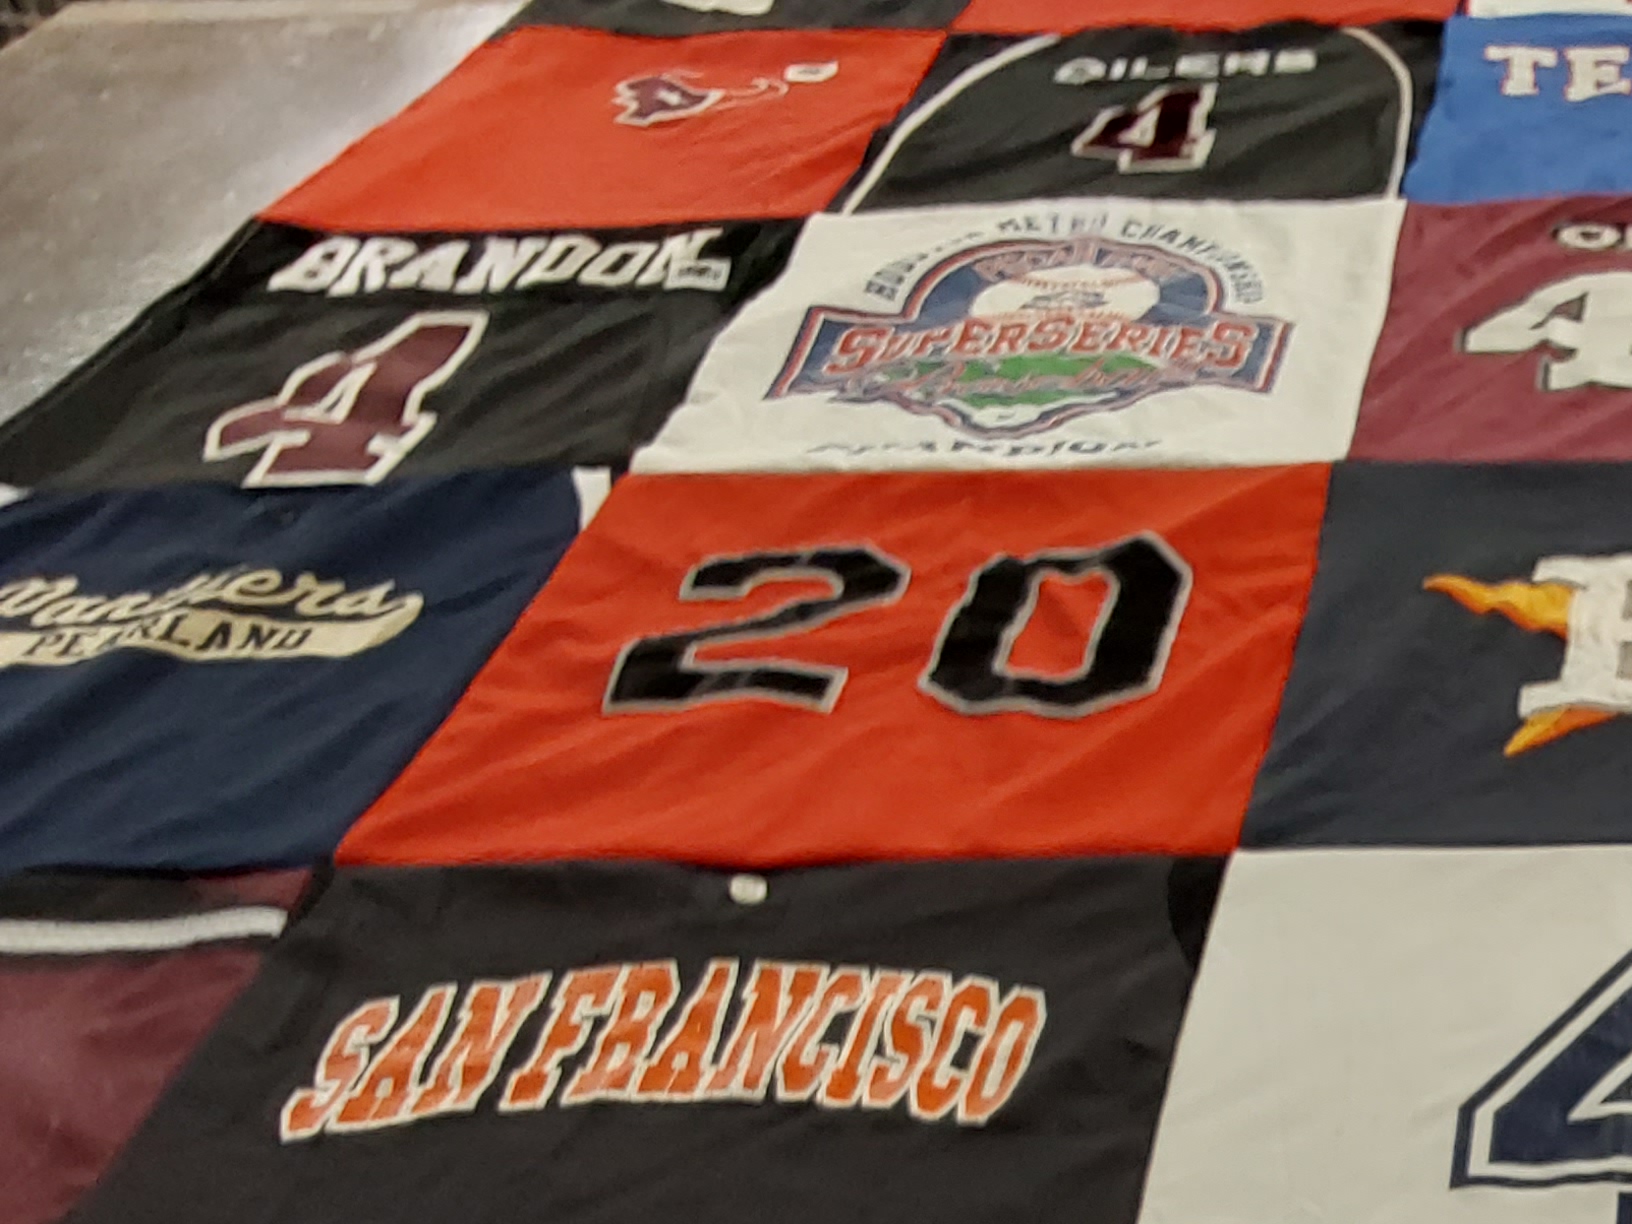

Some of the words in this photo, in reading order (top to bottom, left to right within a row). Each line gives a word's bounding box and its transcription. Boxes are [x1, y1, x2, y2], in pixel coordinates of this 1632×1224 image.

[1070, 81, 1219, 174] 4
[265, 226, 723, 296] BRANDON
[203, 310, 490, 488] 4
[602, 530, 1195, 720] 20
[280, 972, 552, 1144] SAN
[497, 957, 1048, 1125] FRANCISCO
